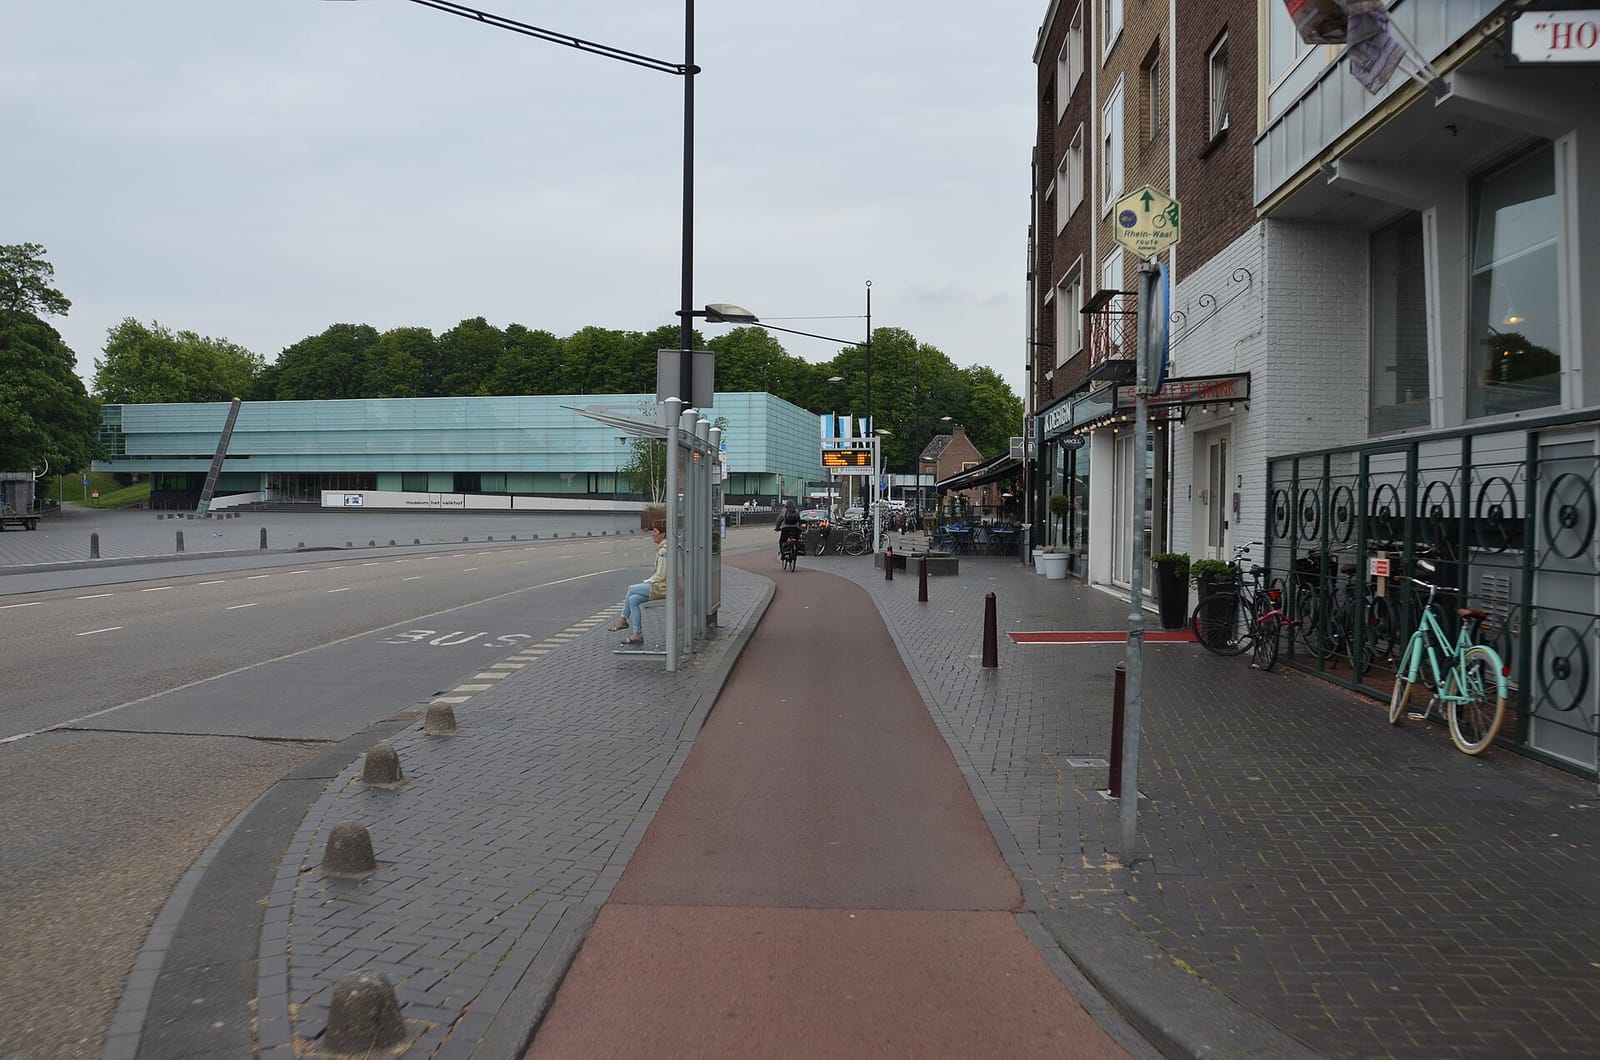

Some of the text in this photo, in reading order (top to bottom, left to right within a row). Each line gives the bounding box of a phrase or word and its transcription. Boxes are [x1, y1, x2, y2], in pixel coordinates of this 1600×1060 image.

[1124, 230, 1173, 238] Rhein-Waal
[1170, 383, 1193, 401] EAT
[1198, 381, 1239, 400] DRINK
[376, 630, 533, 648] BUS
